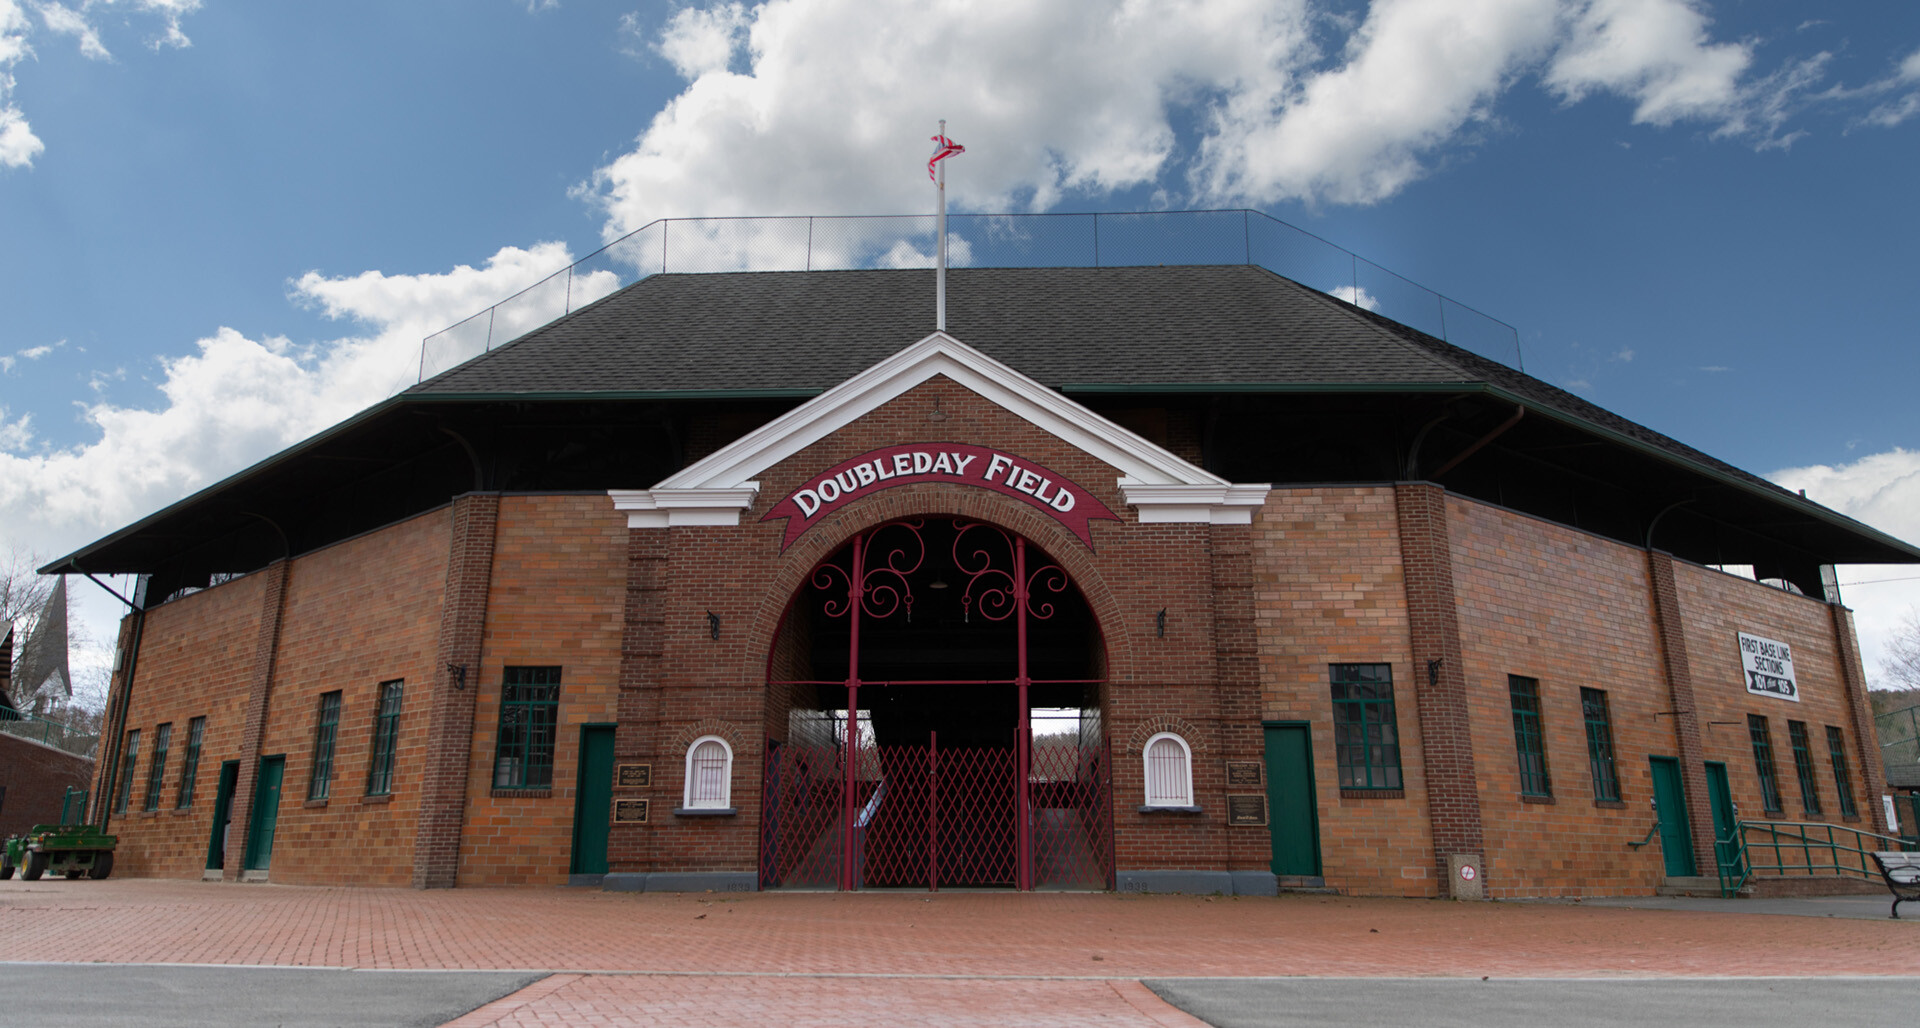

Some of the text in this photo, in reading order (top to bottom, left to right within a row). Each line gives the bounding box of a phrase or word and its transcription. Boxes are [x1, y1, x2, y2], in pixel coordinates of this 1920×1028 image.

[792, 452, 1076, 519] DOUBLEDAY FIELD
[1741, 637, 1791, 662] FIRST BASE LINE
[1754, 656, 1784, 675] SECTIONS
[1754, 674, 1767, 690] 101
[1777, 679, 1790, 694] 105
